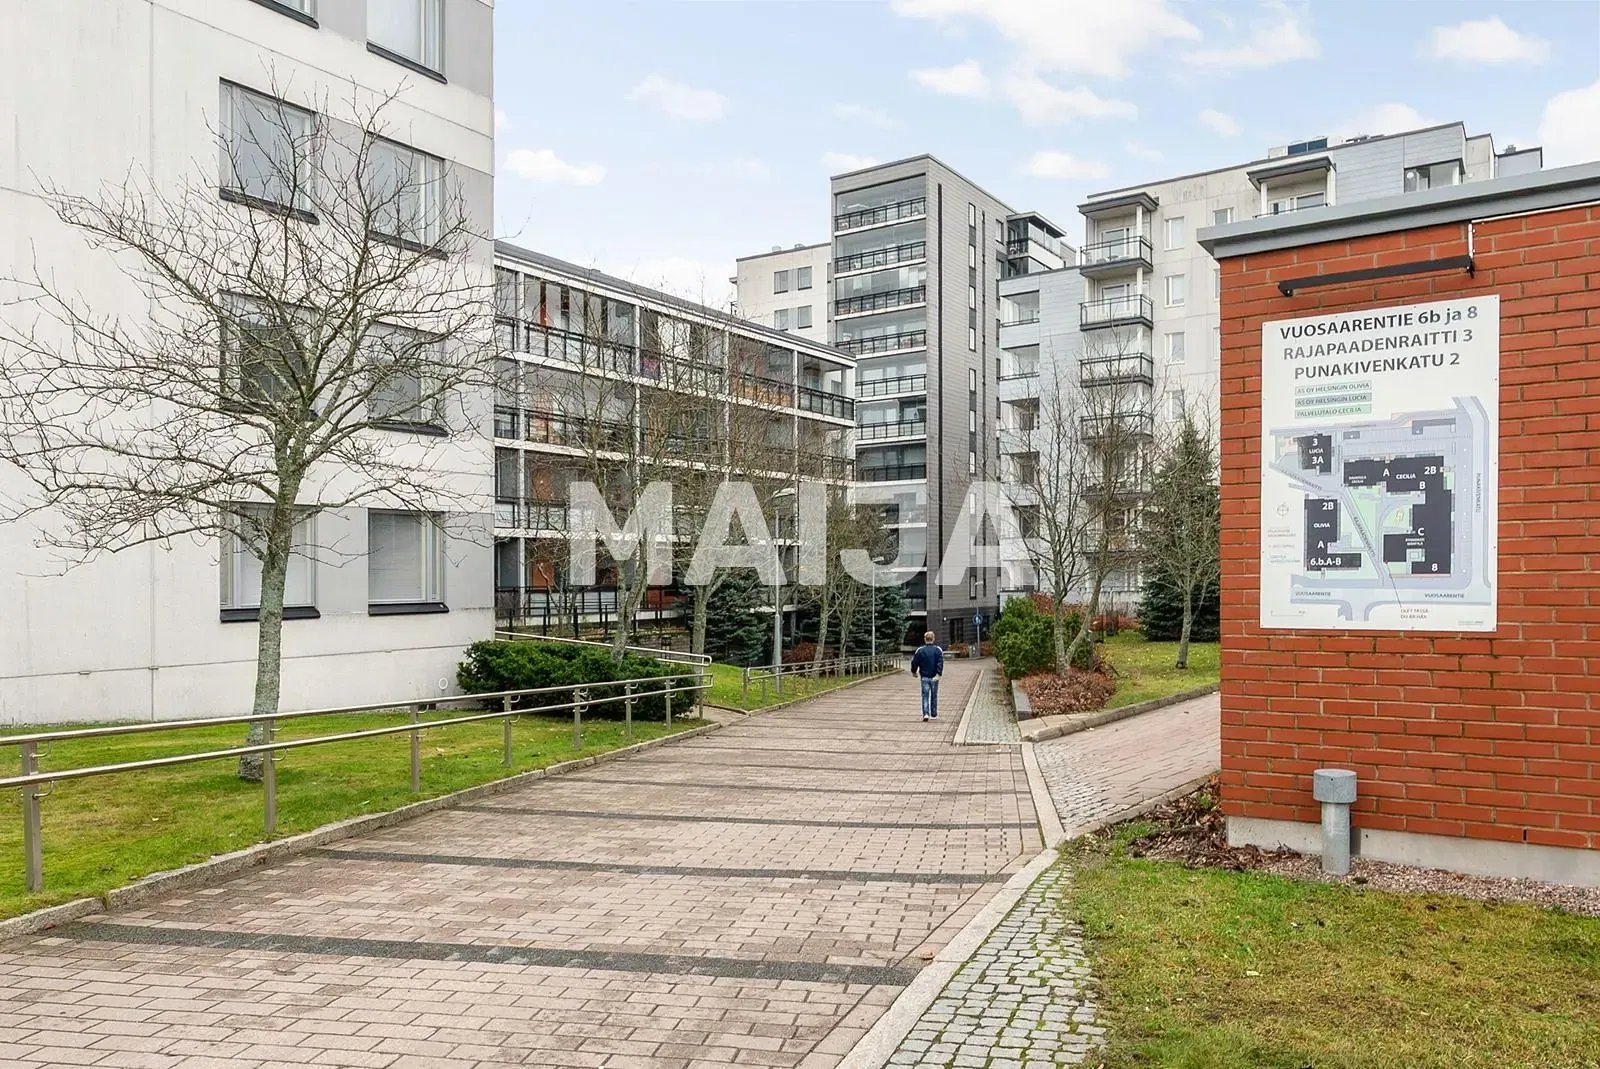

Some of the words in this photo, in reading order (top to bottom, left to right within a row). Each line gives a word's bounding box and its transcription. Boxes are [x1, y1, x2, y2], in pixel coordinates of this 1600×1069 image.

[1280, 312, 1413, 340] VUOSAARENTIE
[1418, 309, 1441, 325] 6b
[1444, 308, 1462, 325] ja
[1467, 305, 1478, 319] 8
[1283, 330, 1457, 360] RAJAPAADENRAITTI
[1462, 329, 1473, 342] 3
[1294, 353, 1444, 380] PUNAKIVENKATU
[1450, 352, 1460, 365] 2
[1349, 382, 1369, 390] OLIVIA
[1316, 396, 1348, 404] HELSINGIN
[1297, 409, 1337, 417] PALVELUTALO
[1312, 438, 1318, 446] 3
[1312, 456, 1324, 465] 3A
[1383, 468, 1390, 477] A
[1424, 466, 1437, 475] 2B
[1419, 481, 1426, 489] B
[1322, 502, 1334, 510] 2B
[1417, 527, 1425, 536] C
[1317, 540, 1325, 549] A
[1431, 563, 1438, 571] 8
